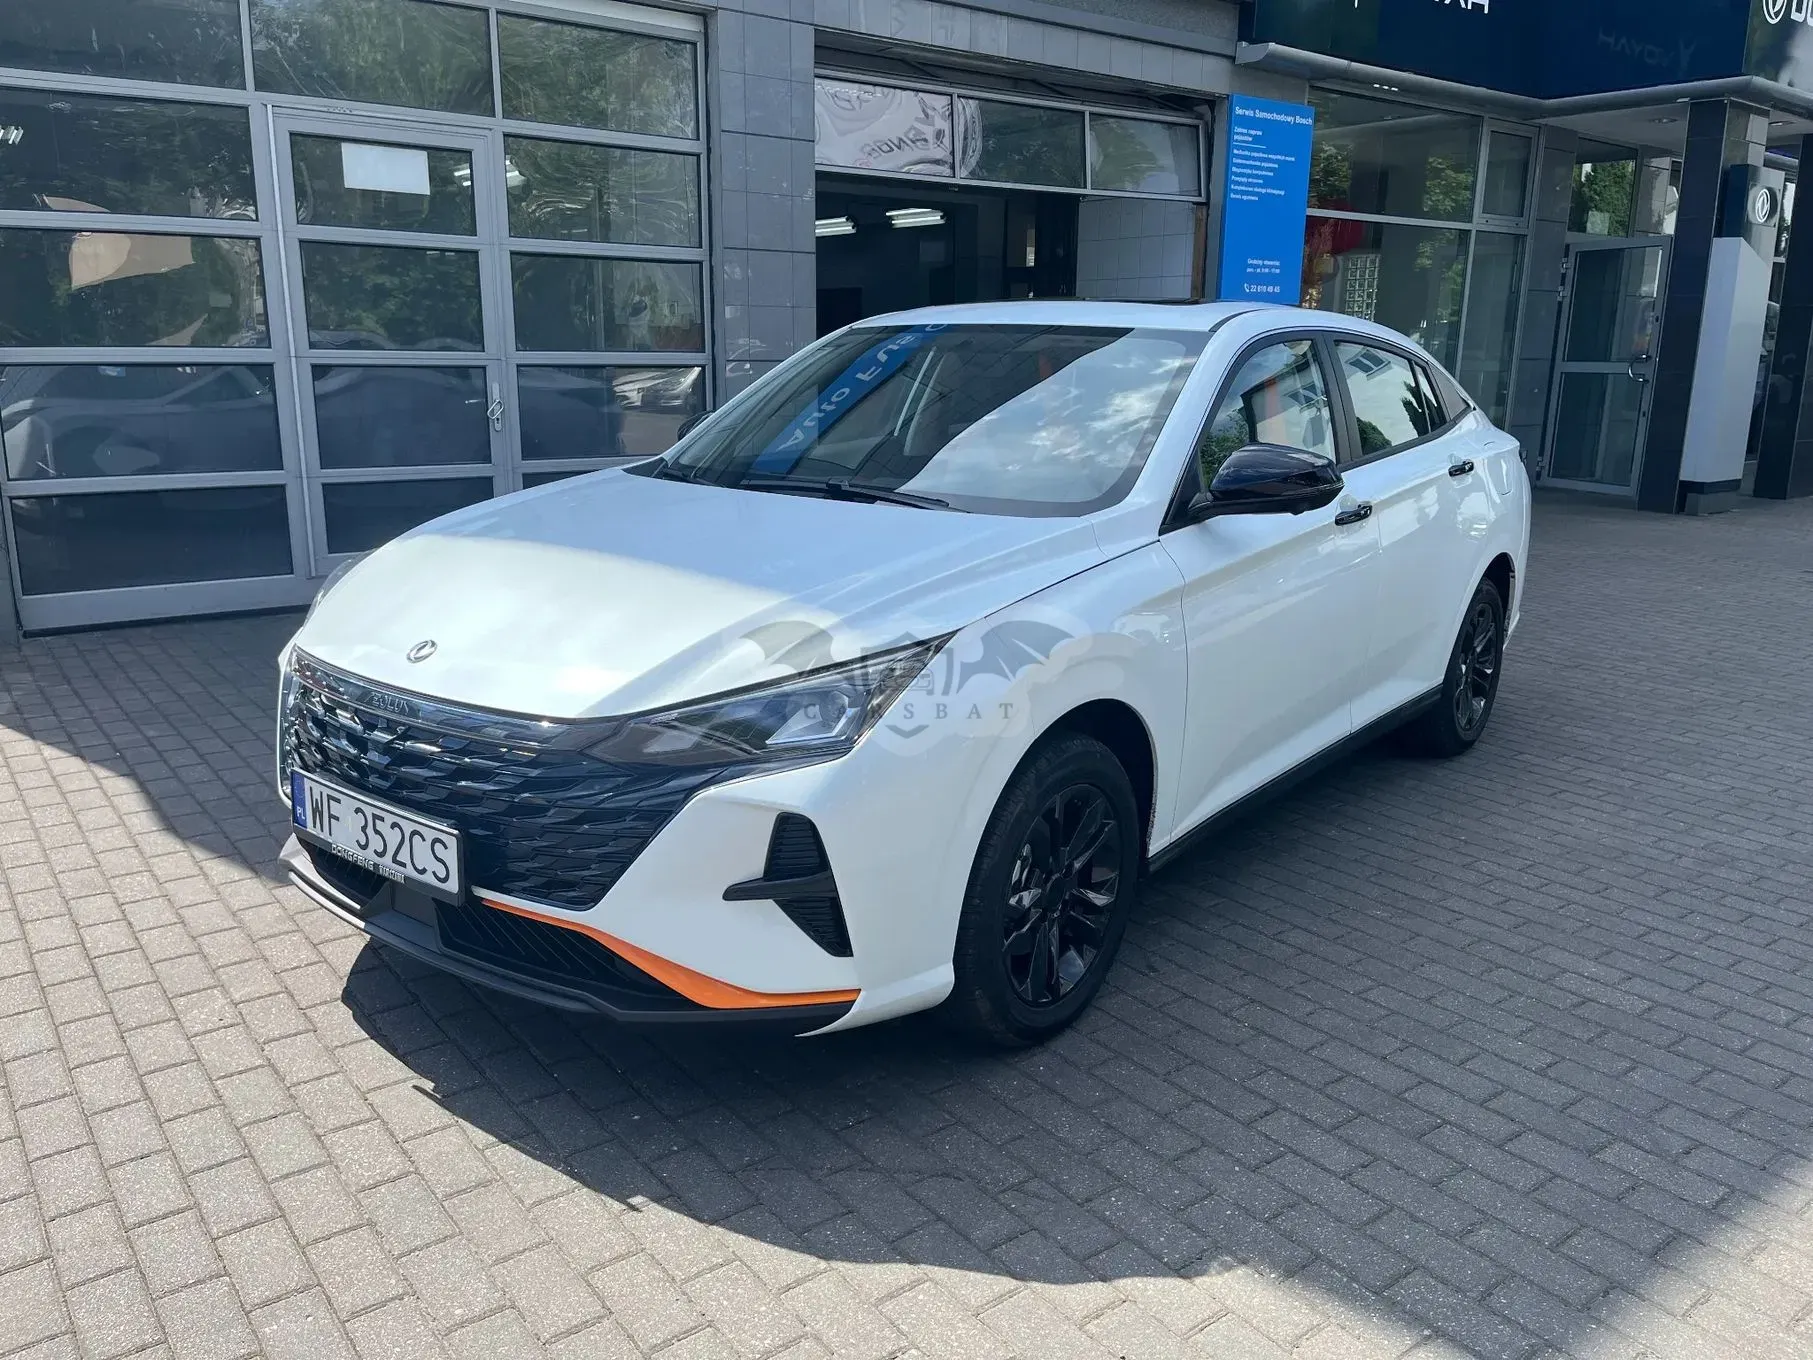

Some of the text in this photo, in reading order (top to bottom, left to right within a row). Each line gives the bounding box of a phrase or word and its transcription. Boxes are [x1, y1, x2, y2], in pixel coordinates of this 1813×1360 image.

[1235, 106, 1313, 126] Serwis Samochodowy Bosch
[296, 806, 306, 820] PL
[309, 786, 450, 884] WF 352CS
[331, 843, 374, 872] DONGFENG
